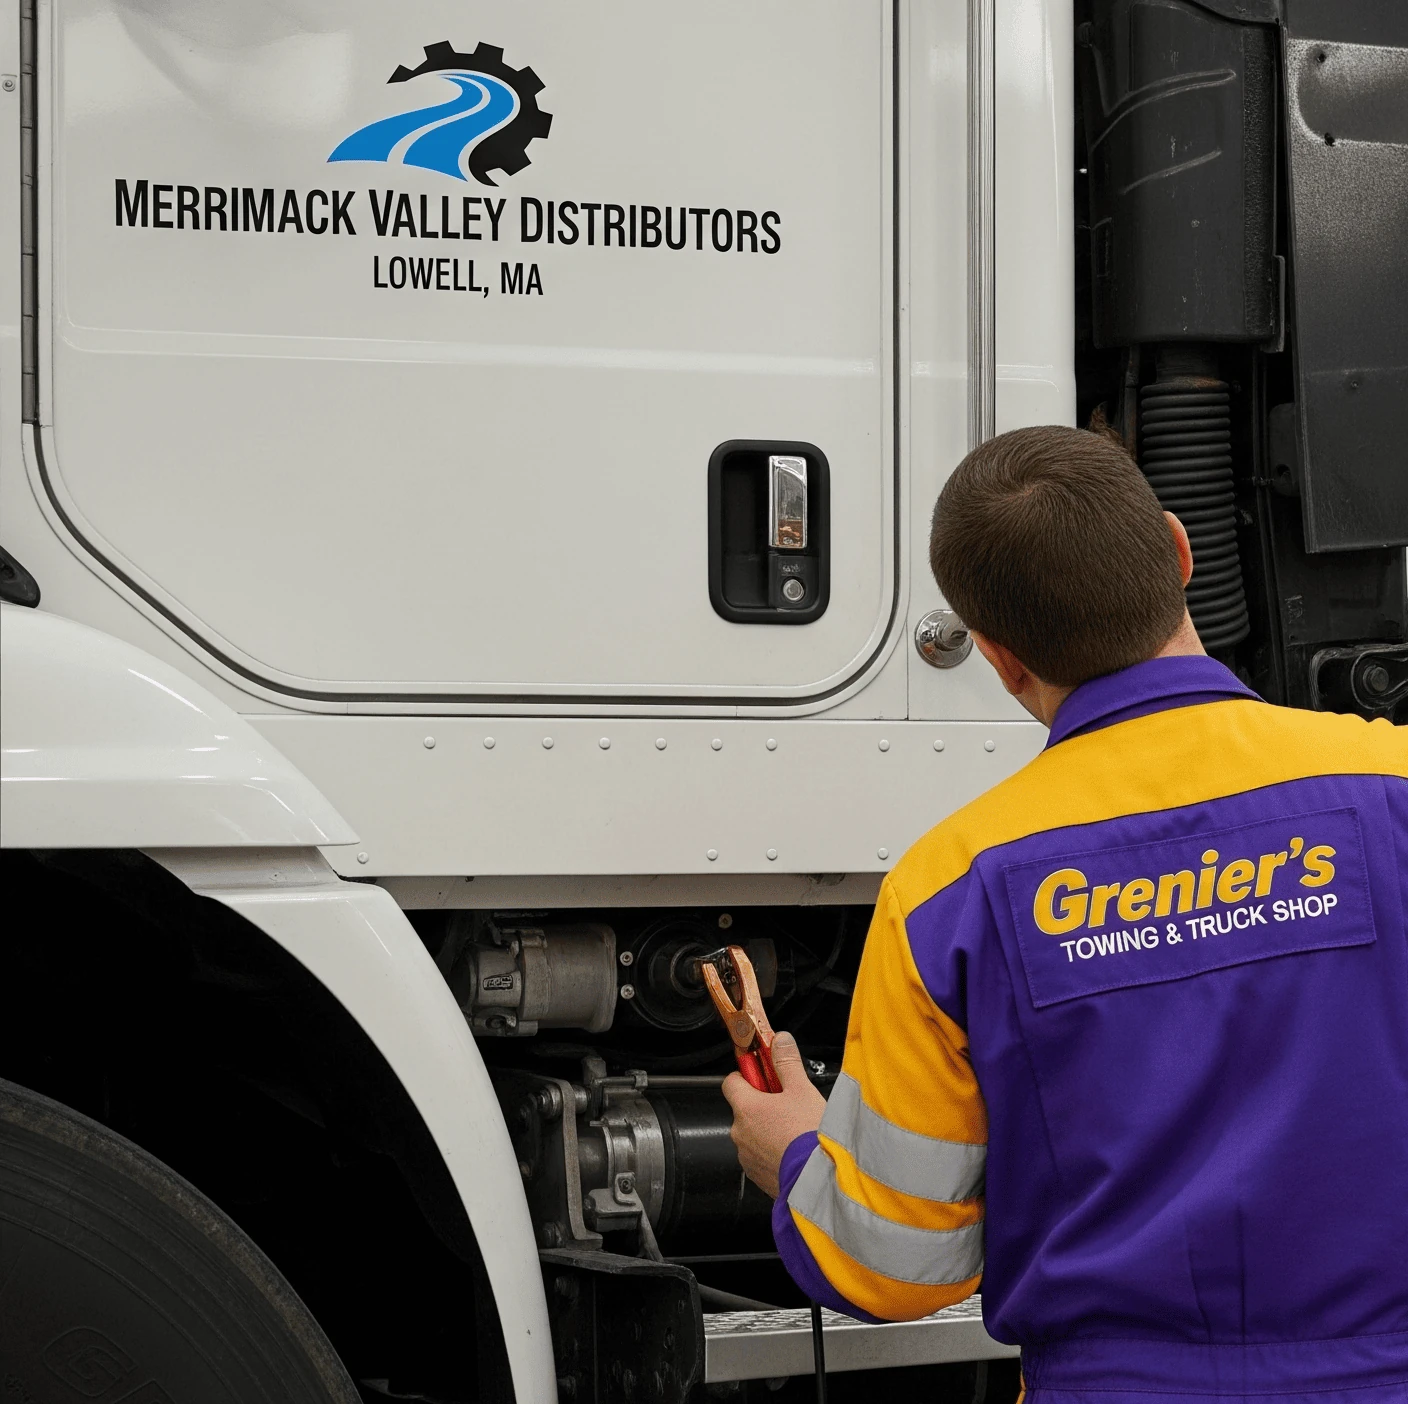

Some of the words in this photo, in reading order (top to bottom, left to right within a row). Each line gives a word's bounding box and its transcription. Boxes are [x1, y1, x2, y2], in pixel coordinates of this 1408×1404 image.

[115, 179, 357, 236] MERRIMACK
[368, 189, 507, 242] VALLEY
[520, 196, 781, 255] DISTRIBUTORS
[373, 256, 489, 299] LOWELL,
[500, 262, 544, 296] MA
[1032, 837, 1337, 935] Grenier's
[1059, 927, 1160, 963] TOWING
[1166, 922, 1183, 945] &
[1185, 906, 1268, 940] TRUCK
[1272, 893, 1339, 922] SHOP
